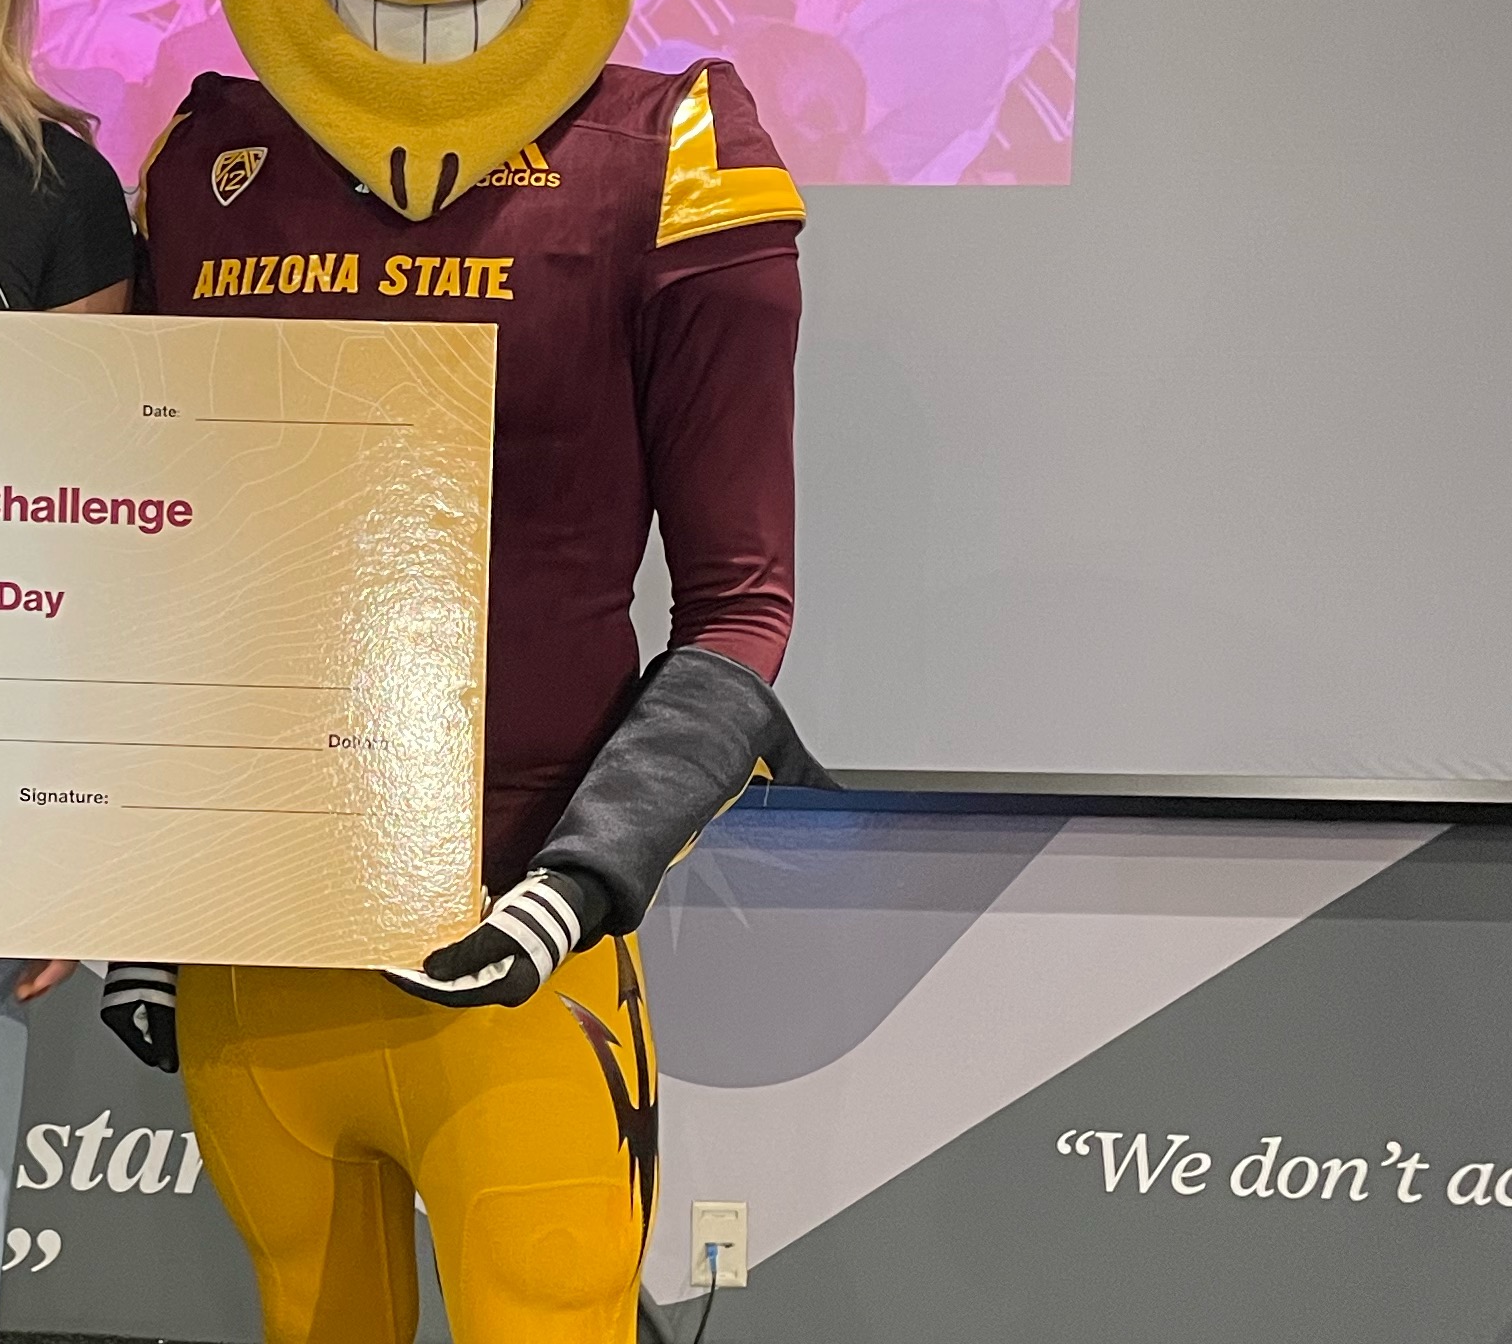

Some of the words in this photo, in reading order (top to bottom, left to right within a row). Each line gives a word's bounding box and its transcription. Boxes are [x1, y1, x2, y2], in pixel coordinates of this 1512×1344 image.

[192, 253, 360, 300] ARIZONA
[377, 254, 515, 300] STATE
[142, 404, 177, 418] Date:
[19, 787, 109, 806] Signature:
[1056, 1129, 1212, 1195] “We
[1230, 1136, 1430, 1203] don’t
